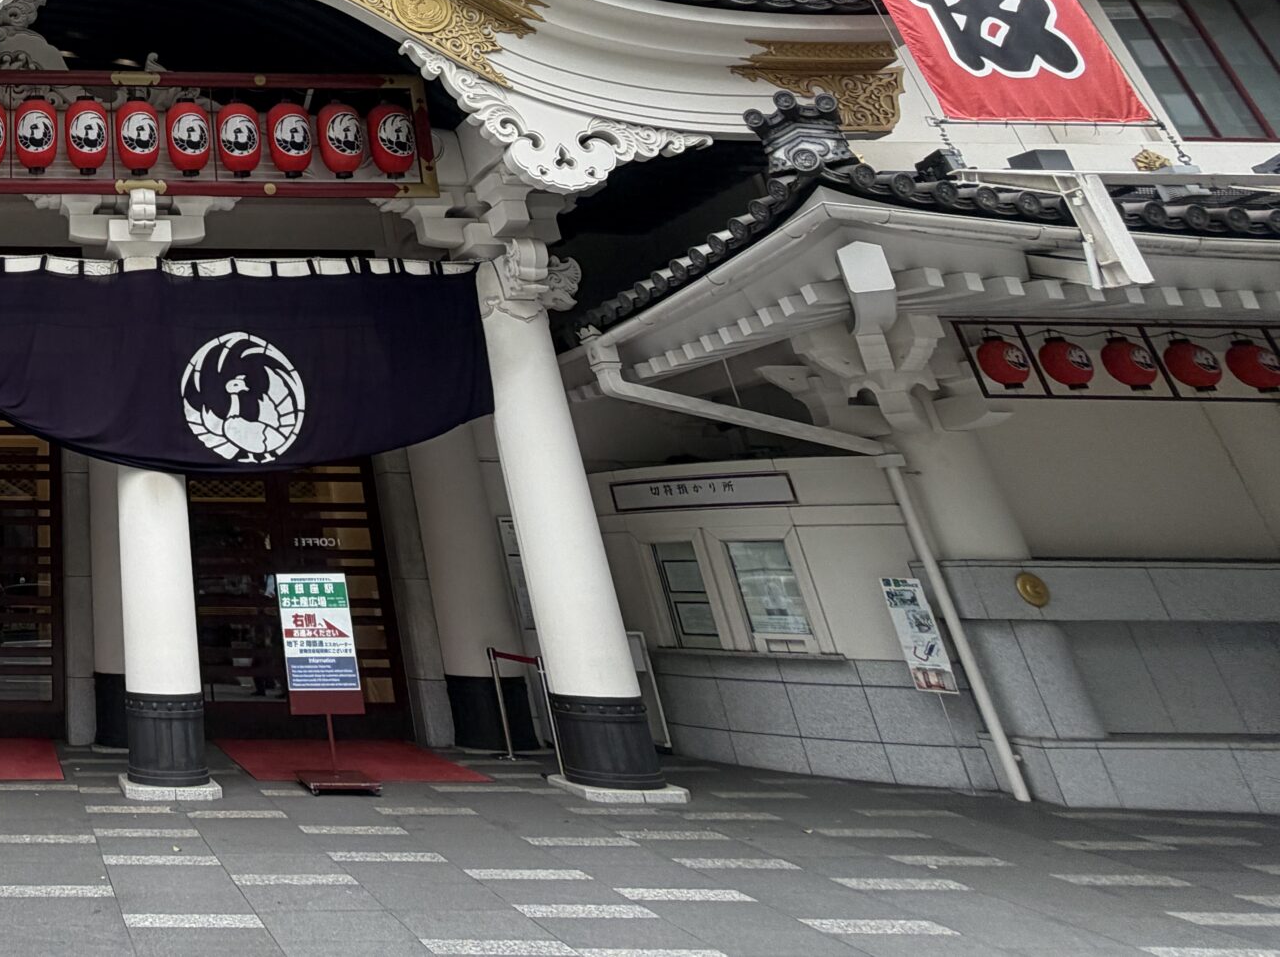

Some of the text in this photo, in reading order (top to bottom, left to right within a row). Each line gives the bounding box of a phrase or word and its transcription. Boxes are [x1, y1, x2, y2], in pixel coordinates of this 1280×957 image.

[649, 480, 735, 496] 切符預かり所
[281, 596, 327, 608] お土産広場
